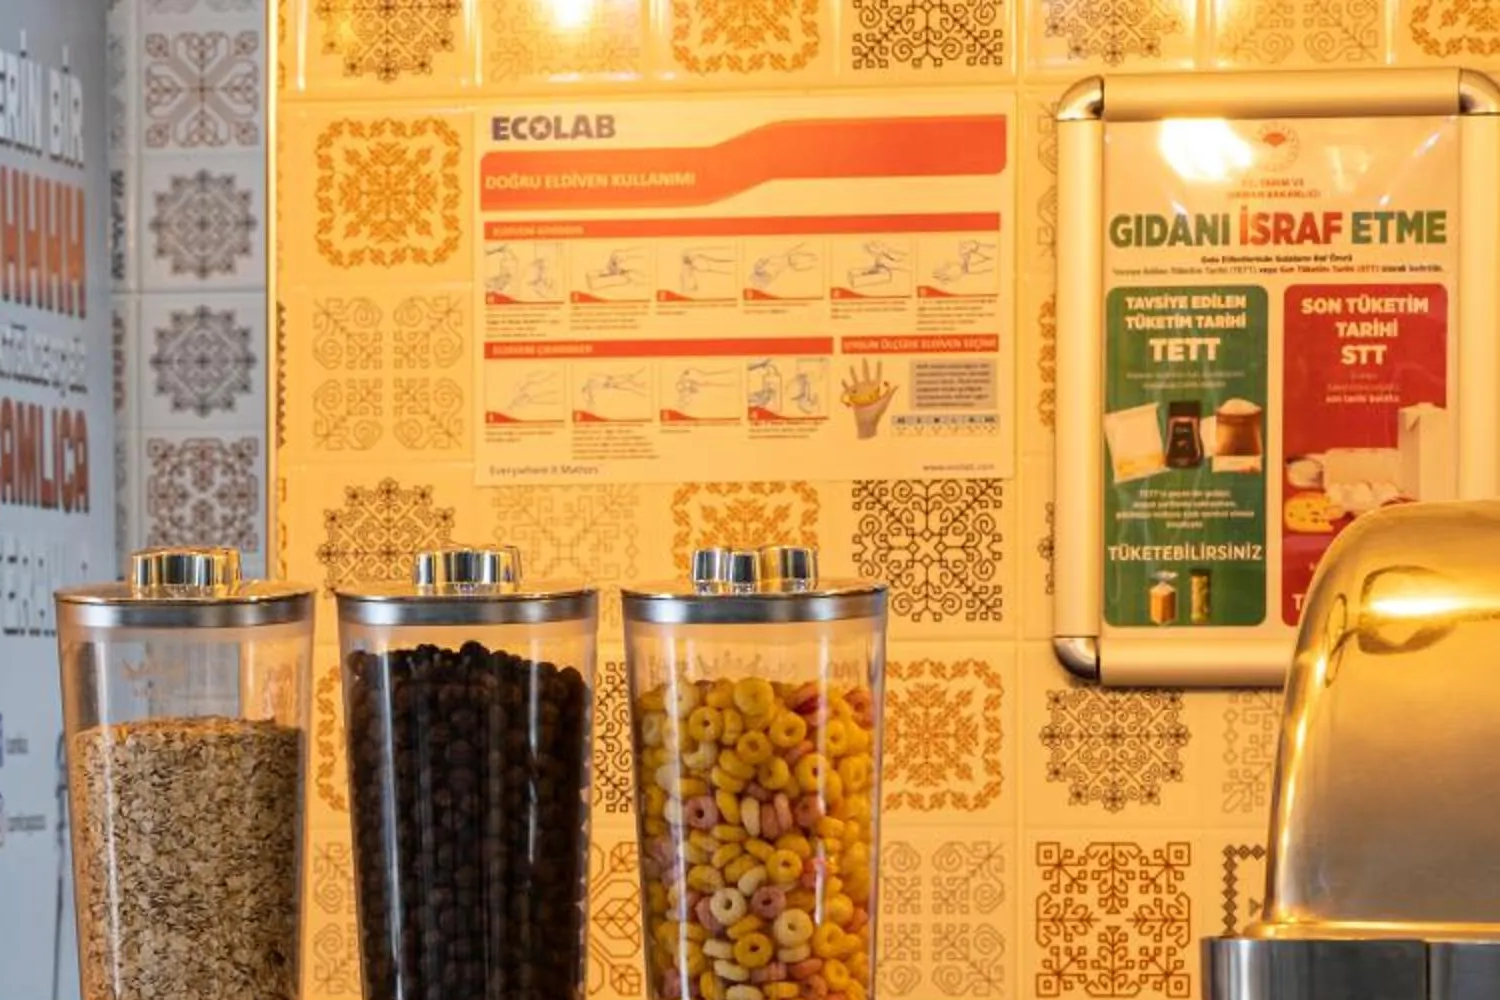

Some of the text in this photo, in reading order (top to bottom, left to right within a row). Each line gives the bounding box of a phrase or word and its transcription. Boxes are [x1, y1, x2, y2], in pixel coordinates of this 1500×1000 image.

[50, 45, 83, 167] BİR
[491, 115, 617, 141] ECOLAB
[485, 171, 697, 190] DOĞRU ELDİVEN KULLANIMI
[1109, 205, 1447, 248] GIDANI İSRAF ETME
[1125, 292, 1247, 310] TAVSİYE EDİLEN
[1301, 294, 1429, 314] SON TÜKETİM
[1125, 311, 1247, 330] TÜKETİM TARİHİ
[1335, 317, 1398, 338] TARİHİ
[1149, 337, 1221, 362] TETT
[1341, 344, 1388, 365] STT
[1108, 541, 1263, 562] TÜKETEBİLİRSİNİZ
